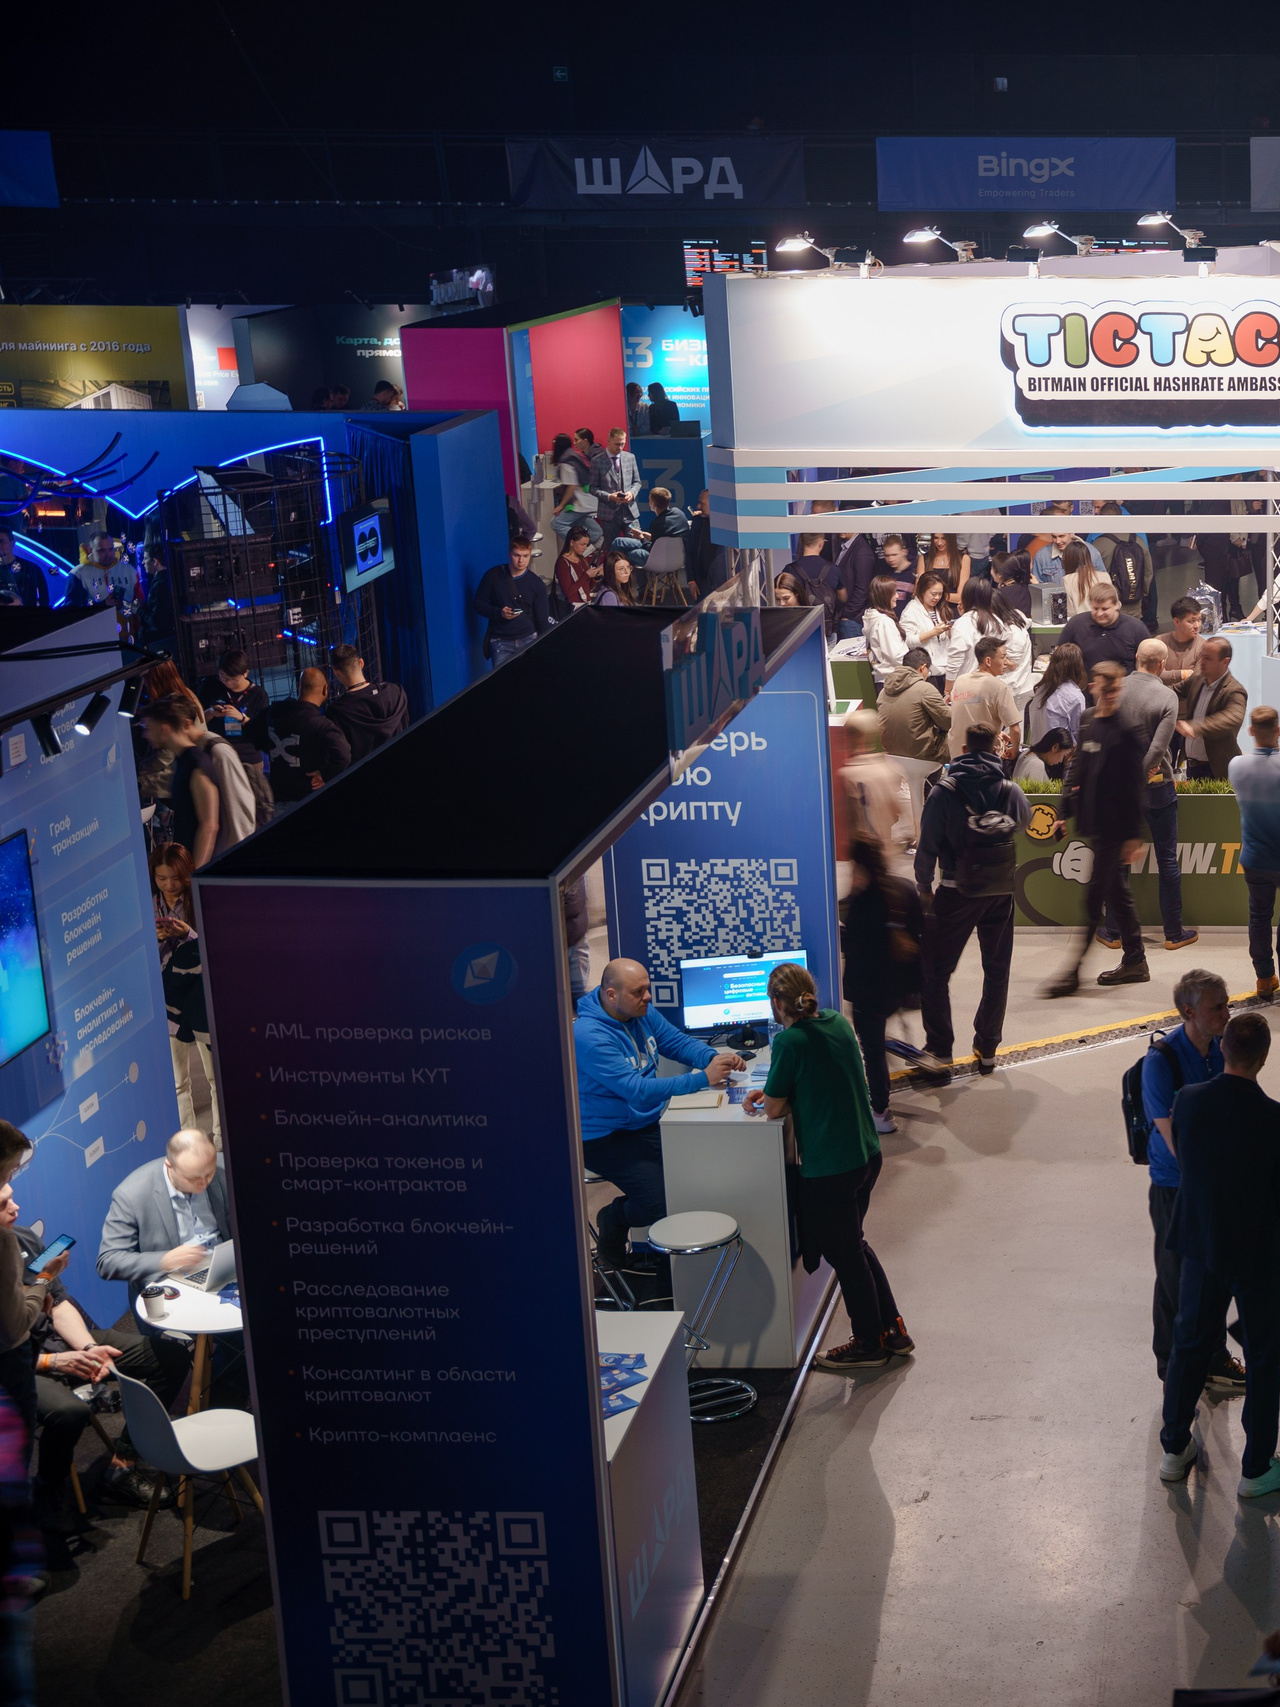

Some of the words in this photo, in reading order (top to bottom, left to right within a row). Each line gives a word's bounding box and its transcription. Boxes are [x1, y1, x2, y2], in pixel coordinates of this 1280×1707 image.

[979, 189, 1036, 198] Empowering
[1040, 189, 1075, 197] Traders
[18, 340, 77, 352] майнинга
[90, 340, 120, 351] 2016
[122, 342, 152, 353] года
[1028, 376, 1087, 392] BITMAIN
[1091, 376, 1150, 392] OFFICIAL
[1153, 376, 1224, 392] HASHRATE
[50, 814, 71, 838] Граф
[52, 817, 99, 857] транзакций
[61, 888, 109, 926] Разработка
[64, 912, 102, 944] блокчейн
[66, 929, 103, 966] решений
[74, 986, 116, 1023] Блокчейн-
[77, 1003, 118, 1041] аналитика
[118, 997, 125, 1009] и
[79, 1009, 134, 1059] исследования
[264, 1023, 311, 1039] AML
[315, 1026, 414, 1044] проверка
[420, 1027, 492, 1044] рисков
[269, 1066, 405, 1087] Инструменты
[411, 1068, 451, 1084] KYT
[274, 1109, 488, 1127] Блокчейн-аналитика
[279, 1152, 379, 1172] Проверка
[384, 1156, 465, 1170] токенов
[472, 1157, 483, 1169] и
[281, 1178, 468, 1195] смарт-контрактов
[286, 1217, 405, 1236] Разработка
[410, 1218, 514, 1234] блокчейн-
[288, 1239, 379, 1258] решений
[293, 1280, 450, 1299] Расследование
[295, 1306, 460, 1321] криптовалютных
[297, 1326, 436, 1344] преступлений
[302, 1366, 416, 1381] Консалтинг
[421, 1370, 432, 1381] в
[437, 1367, 517, 1382] области
[304, 1389, 432, 1405] криптовалют
[309, 1427, 497, 1445] Крипто-комплаенс
